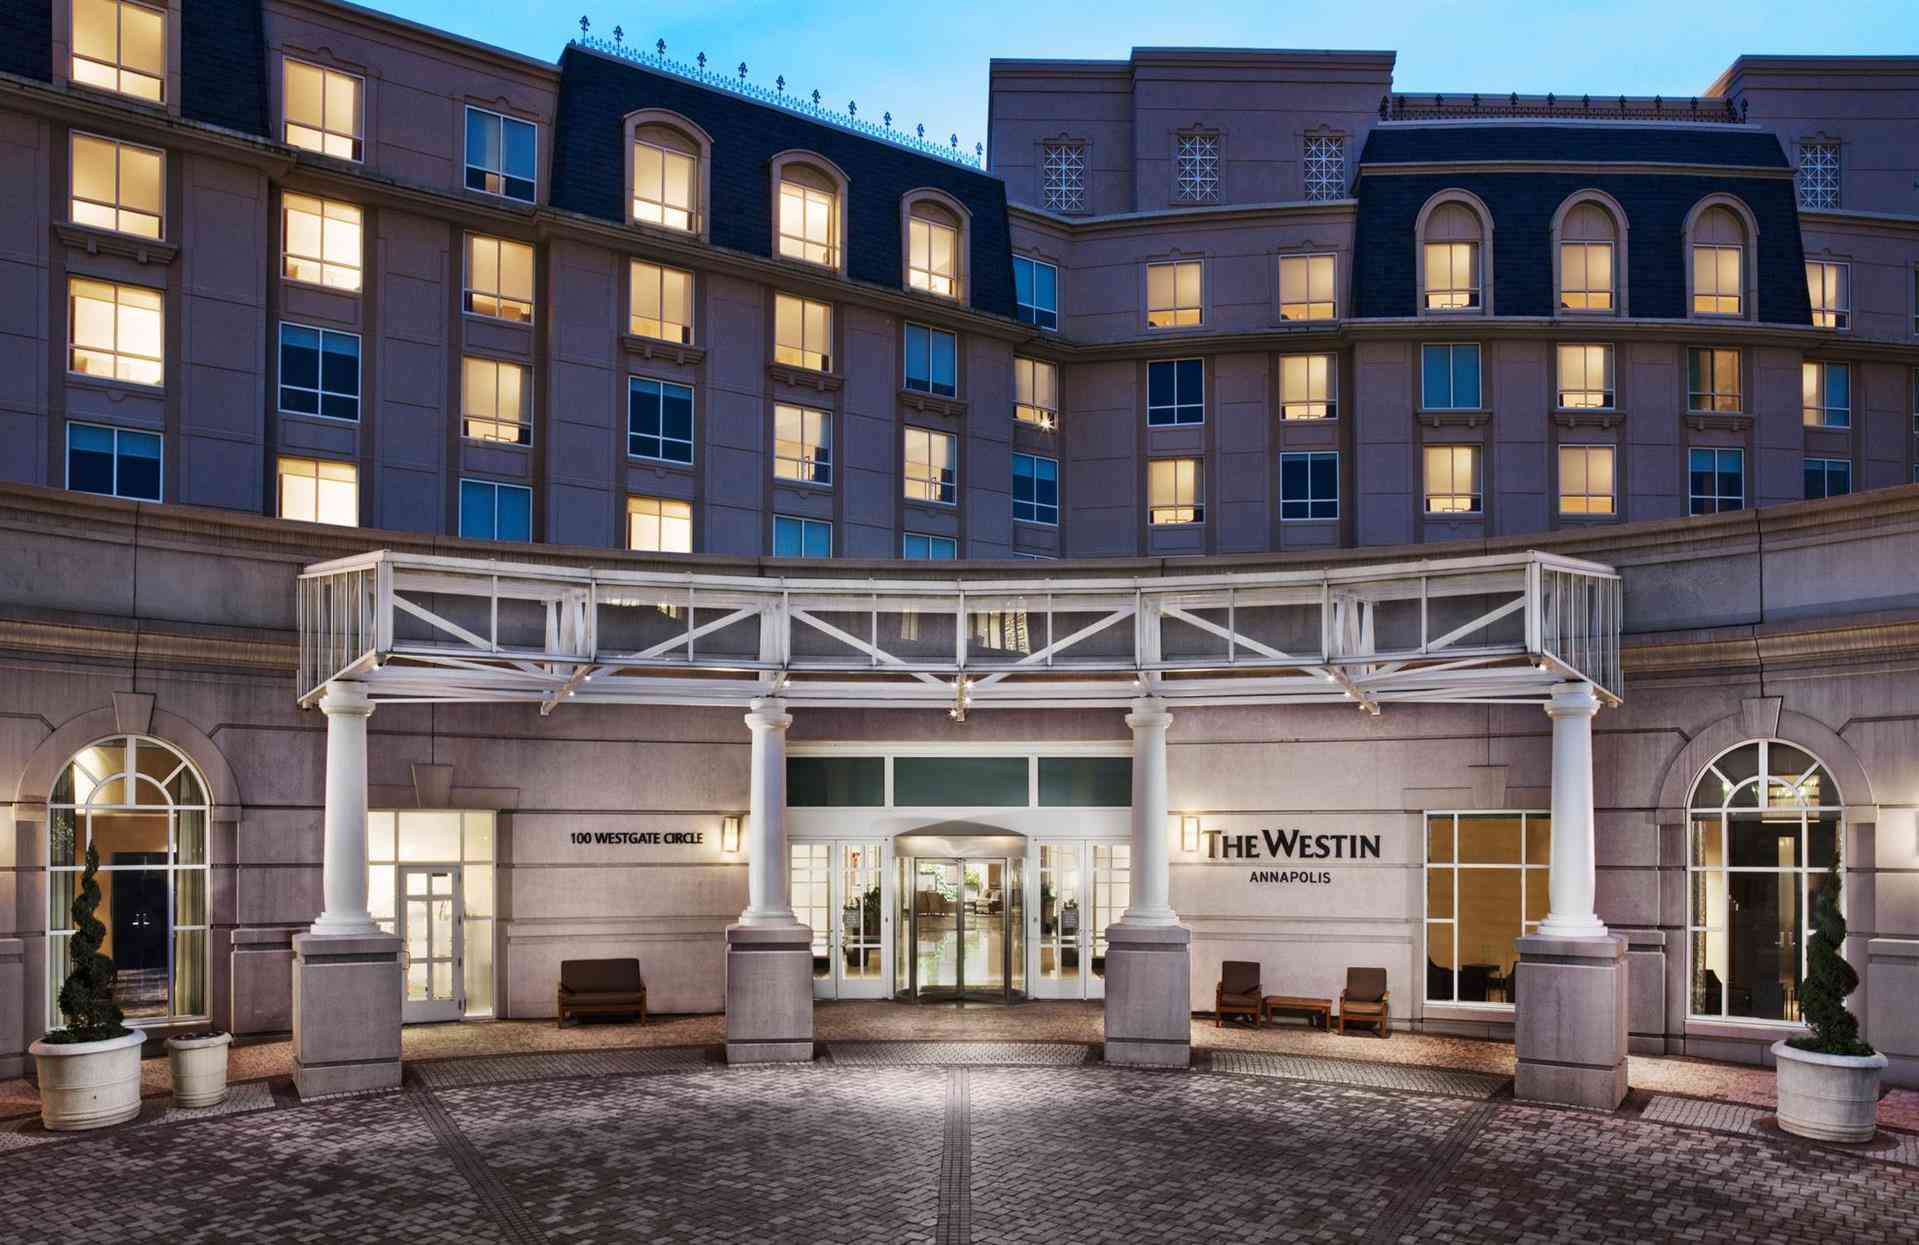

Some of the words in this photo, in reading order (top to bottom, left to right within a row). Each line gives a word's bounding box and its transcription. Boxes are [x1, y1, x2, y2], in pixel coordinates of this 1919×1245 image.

[570, 832, 593, 845] 100
[593, 832, 661, 845] WESTGATE
[663, 832, 704, 845] CIRCLE
[1202, 829, 1261, 859] THE
[1261, 829, 1381, 859] WESTIN
[1249, 871, 1331, 884] ANNAPOLIS
